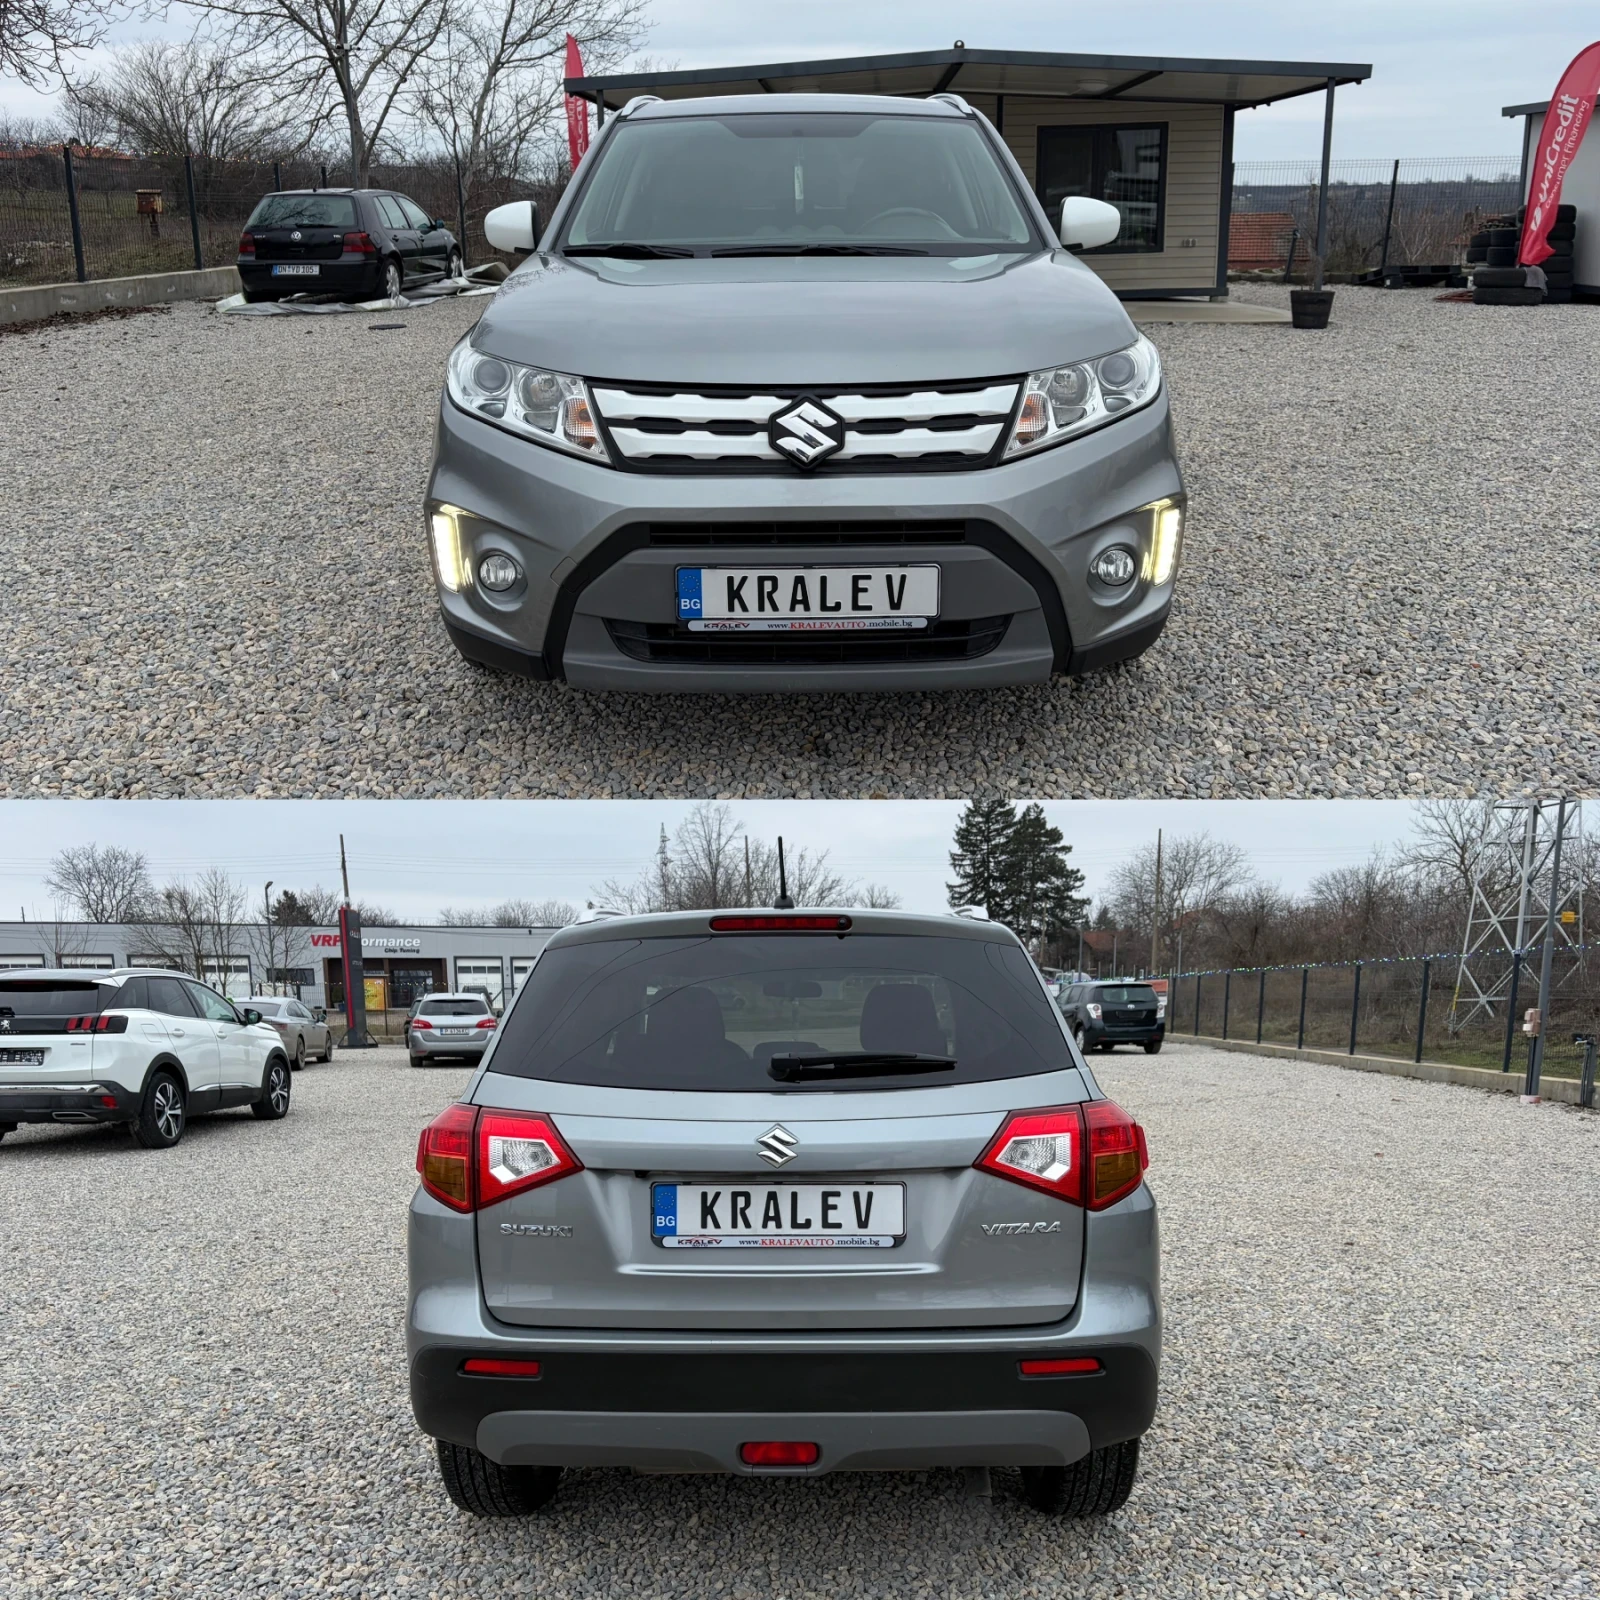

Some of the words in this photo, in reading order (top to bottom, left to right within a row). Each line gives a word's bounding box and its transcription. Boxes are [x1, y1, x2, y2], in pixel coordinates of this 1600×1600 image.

[1538, 93, 1579, 203] UniCredit
[1546, 155, 1570, 209] Consumer
[1563, 100, 1590, 154] Financing
[301, 265, 314, 274] 105
[726, 573, 907, 613] KRALEV
[681, 598, 701, 610] BG
[767, 620, 913, 631] www.KRALEVAUTO.mobile.bg
[700, 1190, 874, 1230] KRALEV
[656, 1215, 675, 1227] BG
[980, 1221, 1062, 1236] VITARA
[500, 1223, 573, 1238] SUZUKI
[739, 1237, 880, 1247] www.KRALEVAUTO.mobile.bg
